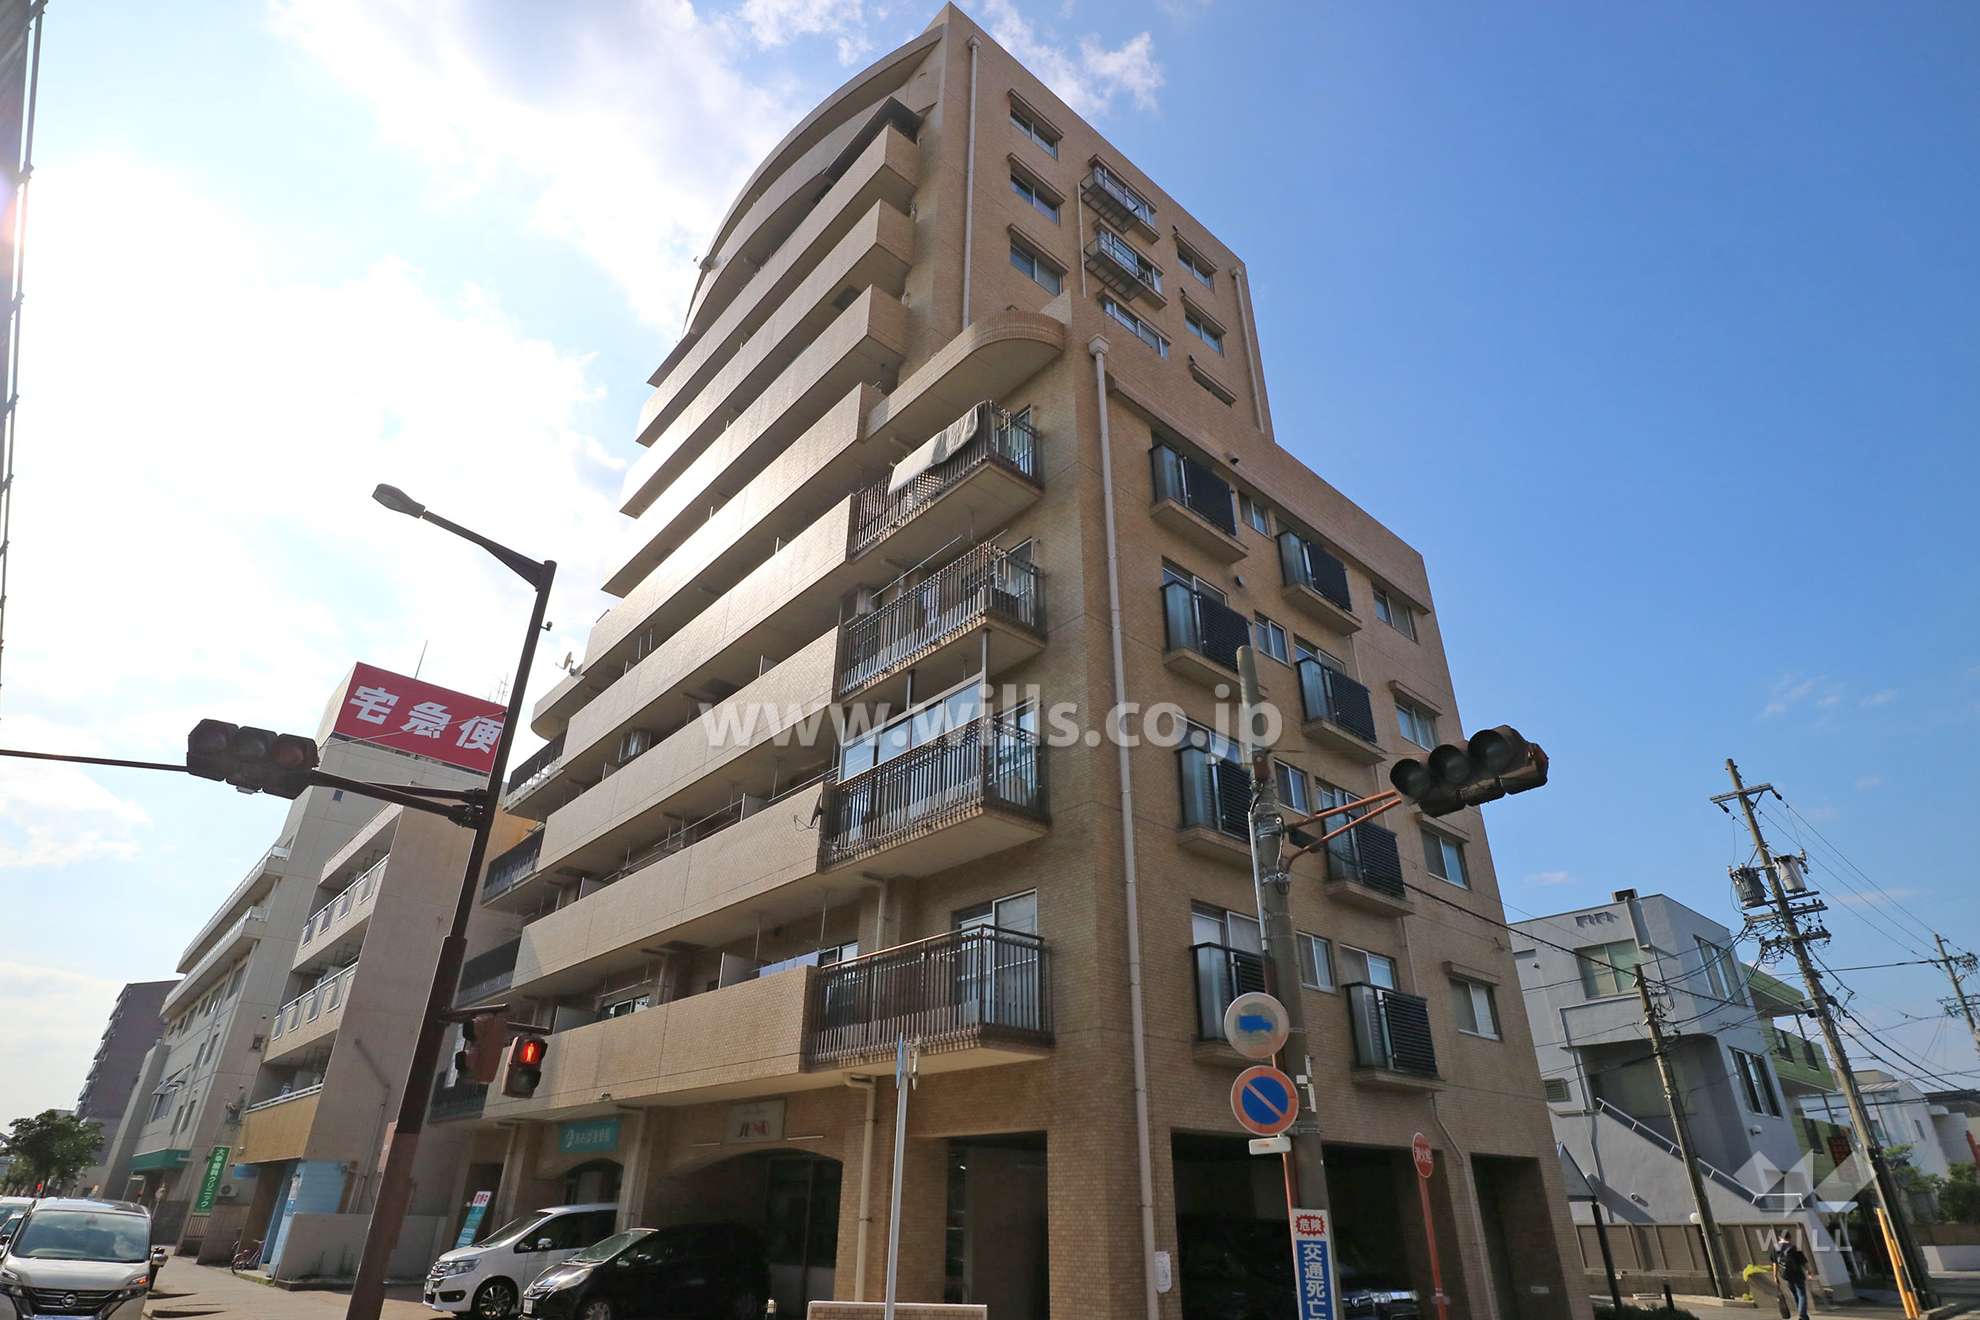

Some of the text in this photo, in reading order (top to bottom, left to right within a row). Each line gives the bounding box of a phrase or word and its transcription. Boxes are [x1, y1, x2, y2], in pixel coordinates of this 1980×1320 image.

[349, 686, 503, 755] 宅急便
[1299, 1218, 1322, 1232] 危険
[1303, 1242, 1328, 1320] 交通死亡
